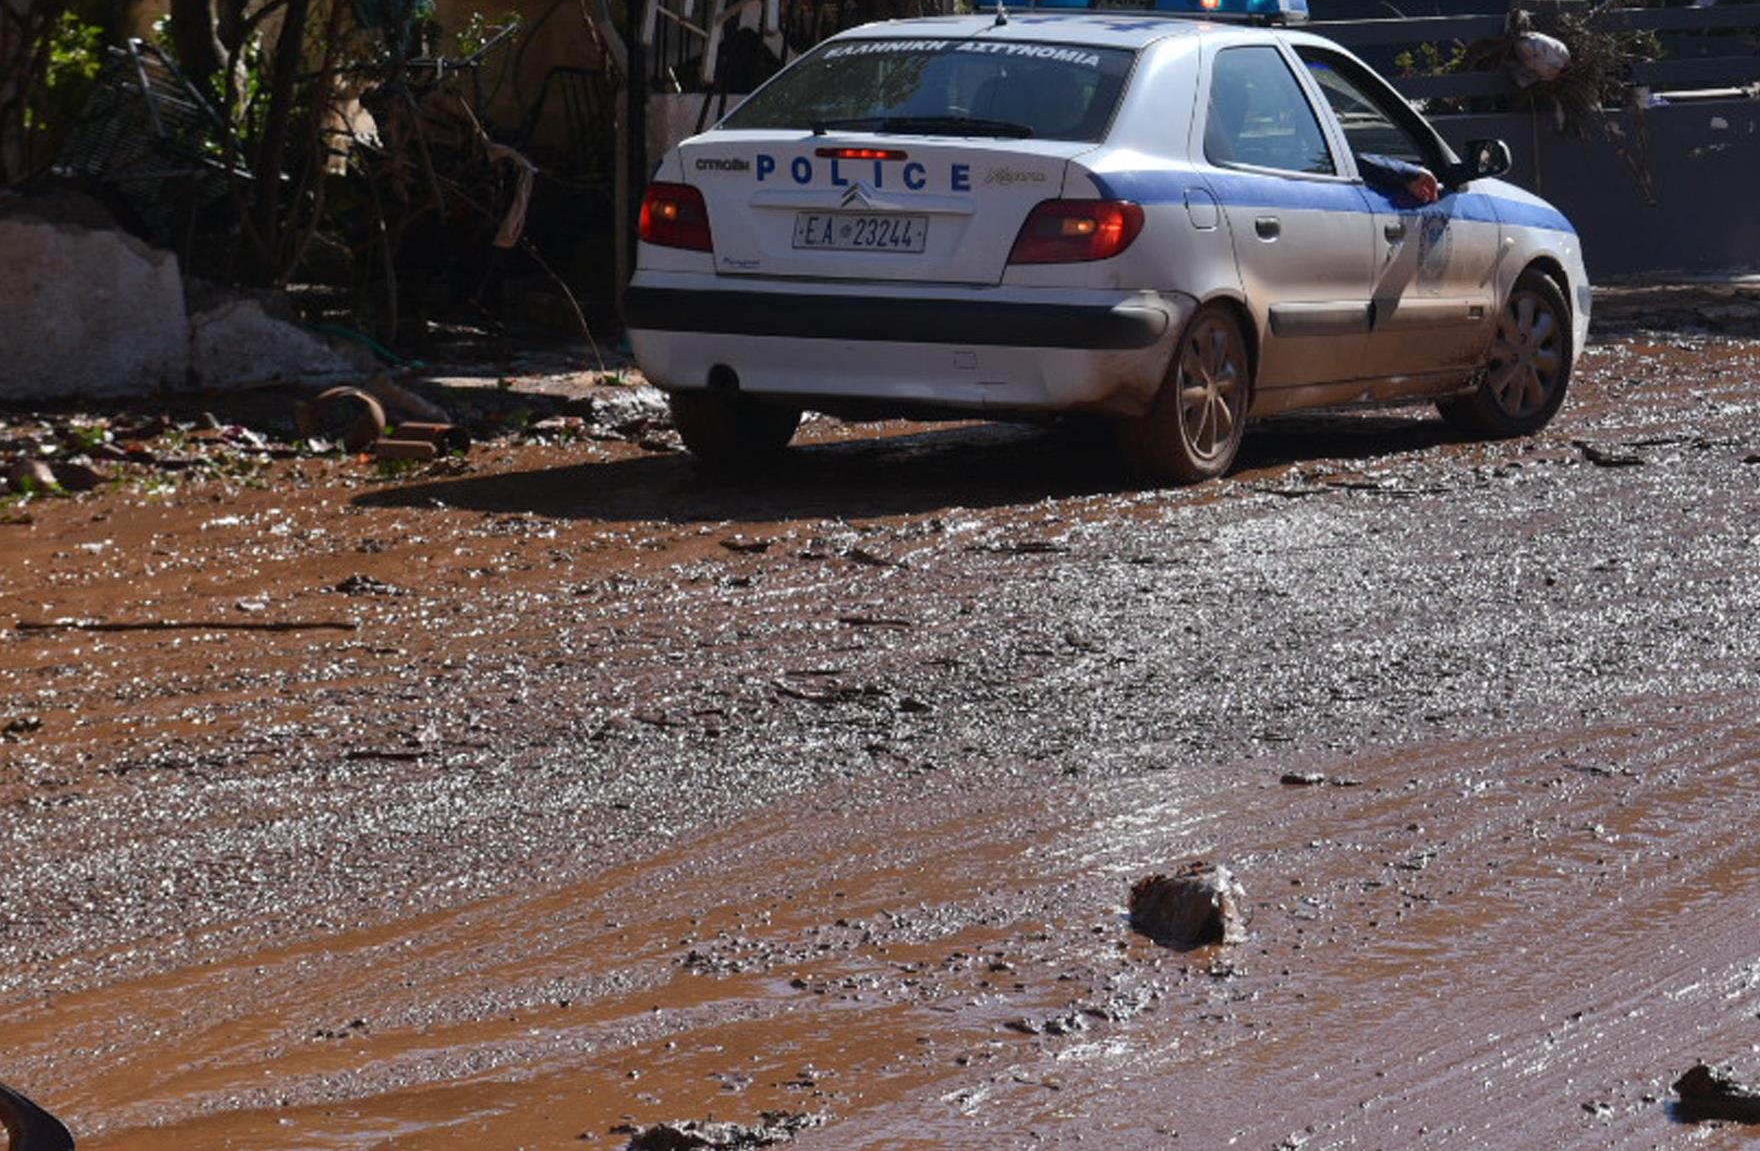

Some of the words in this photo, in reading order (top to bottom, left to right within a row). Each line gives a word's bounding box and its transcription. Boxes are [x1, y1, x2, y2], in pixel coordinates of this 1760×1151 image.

[956, 42, 1101, 67] ΑΣΤΥΝΟΜΙΑ
[756, 153, 972, 192] POLICE
[853, 219, 912, 248] 23244
